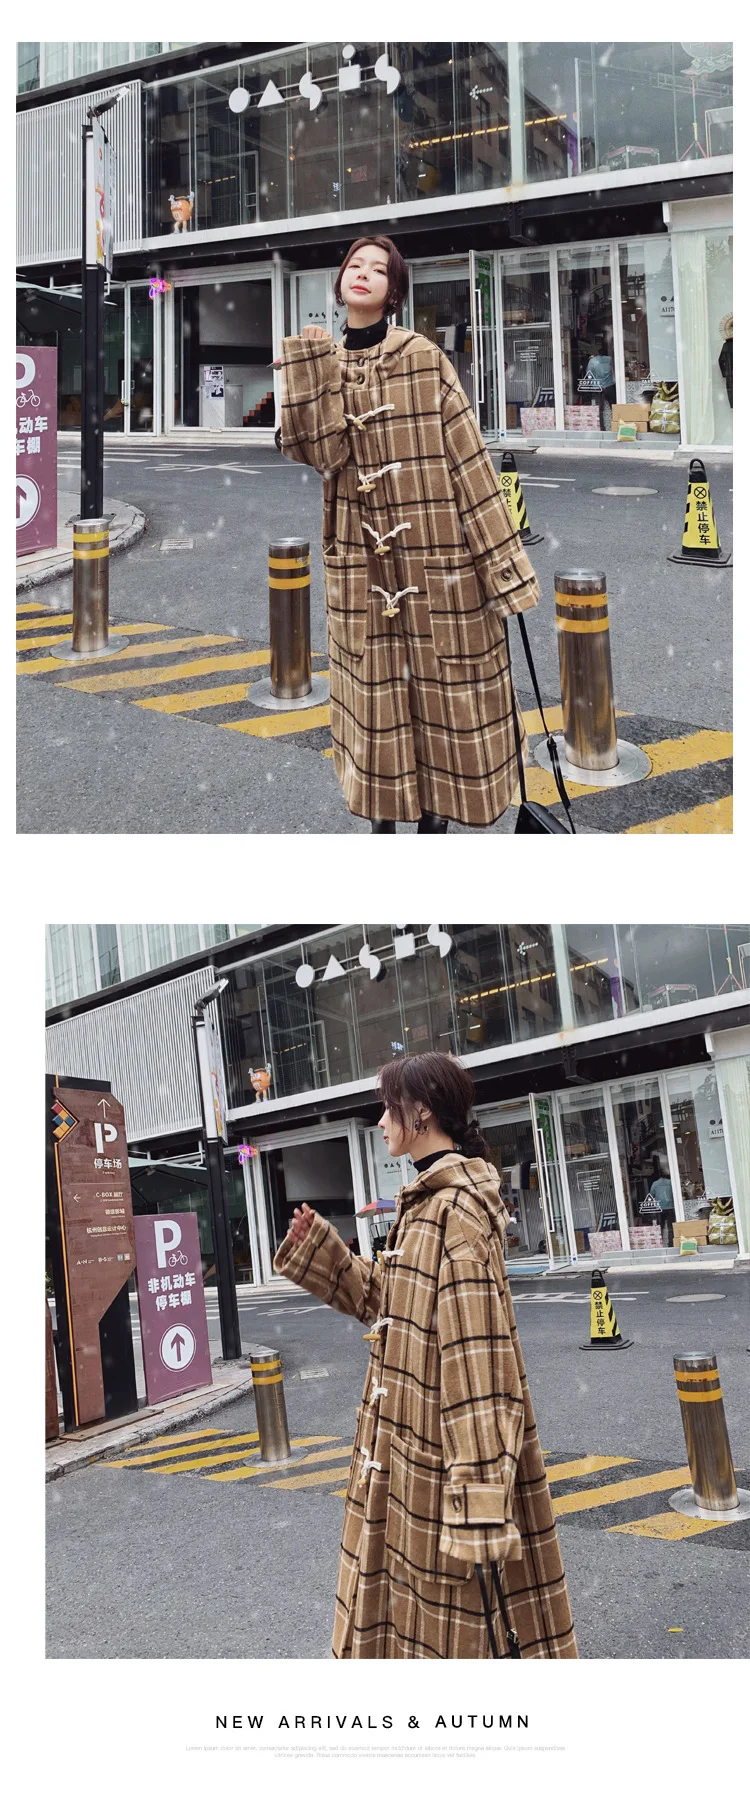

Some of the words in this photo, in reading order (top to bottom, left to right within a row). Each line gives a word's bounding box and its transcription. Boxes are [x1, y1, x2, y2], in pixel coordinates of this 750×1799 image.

[696, 500, 711, 545] 禁止停车
[94, 1122, 118, 1153] P
[94, 1158, 122, 1169] 停车场
[154, 1220, 182, 1268] P
[148, 1272, 196, 1293] 非机动车
[156, 1290, 192, 1311] 停车棚
[595, 1301, 606, 1335] 禁止停车
